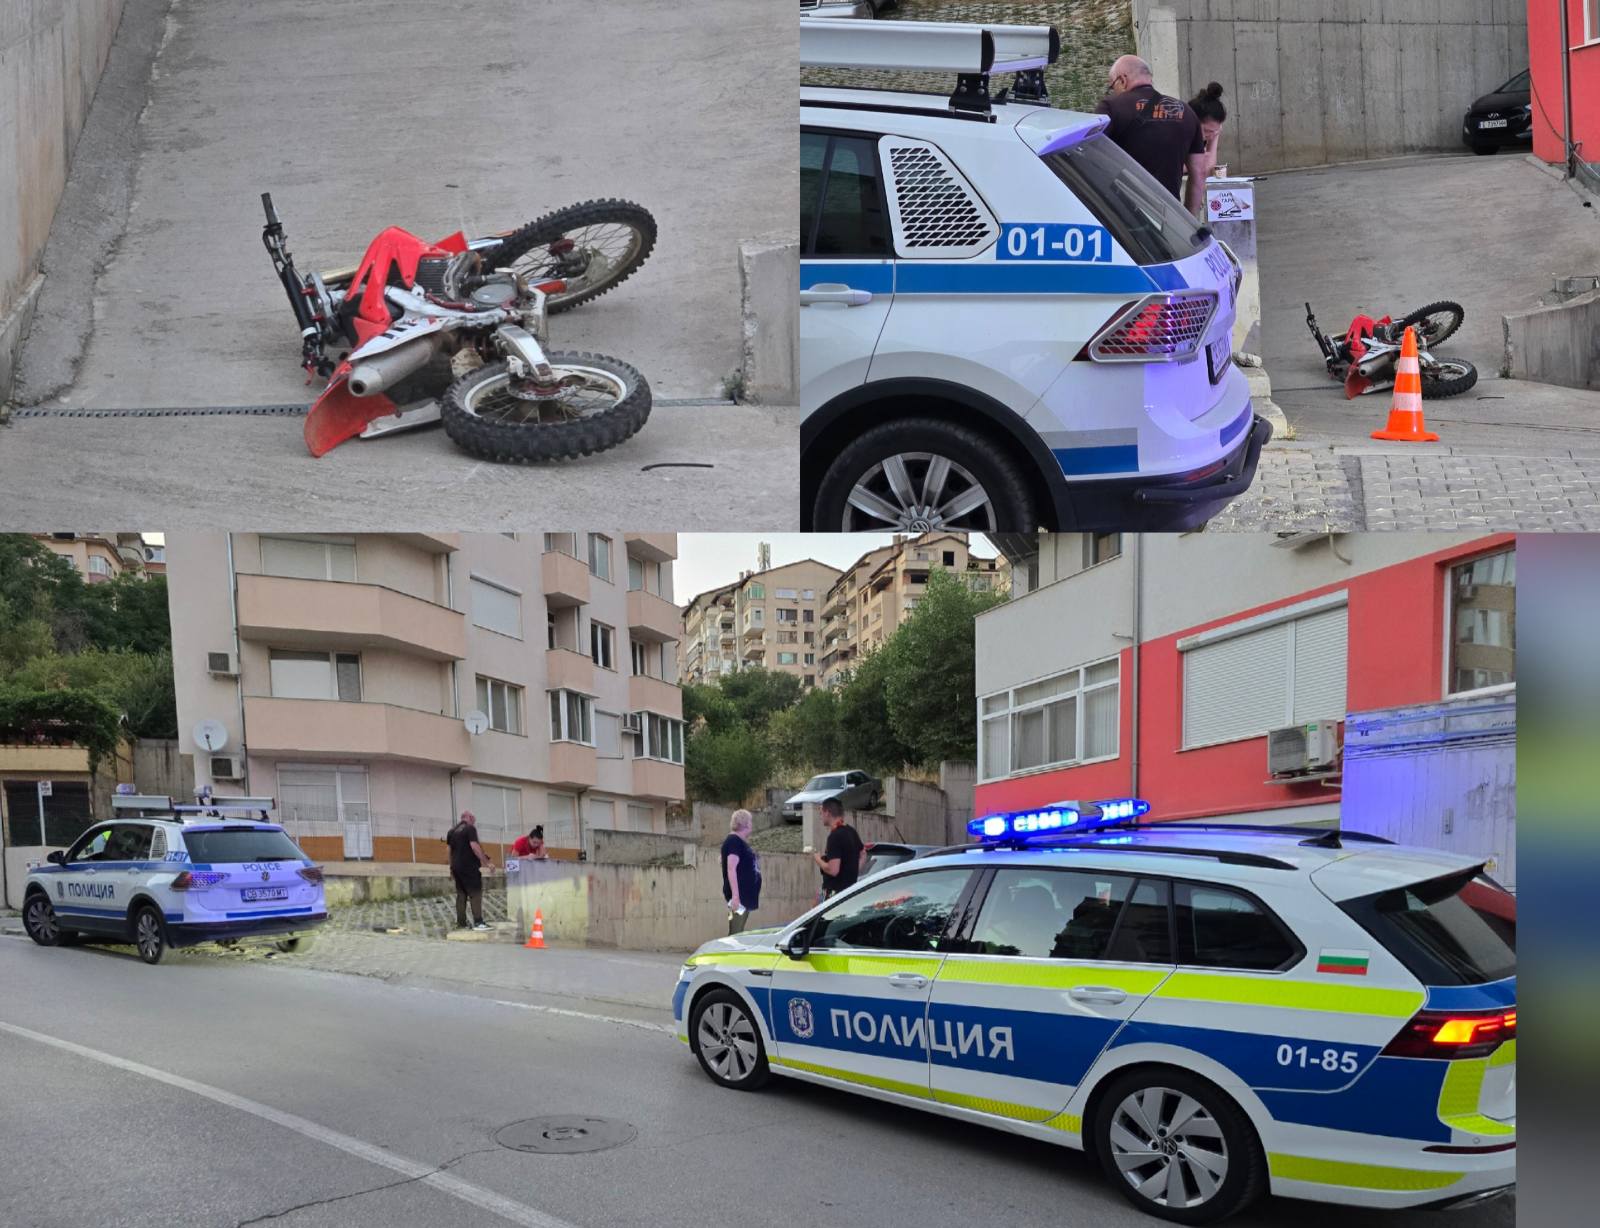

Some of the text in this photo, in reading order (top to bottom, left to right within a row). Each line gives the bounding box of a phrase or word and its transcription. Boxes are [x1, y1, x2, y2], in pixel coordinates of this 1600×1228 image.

[1007, 227, 1102, 258] 01-01
[242, 863, 282, 872] POLICE
[68, 882, 115, 900] ПОЛИЦИЯ
[830, 1008, 1015, 1061] ПОЛИЦИЯ
[1276, 1043, 1359, 1073] 01-85
